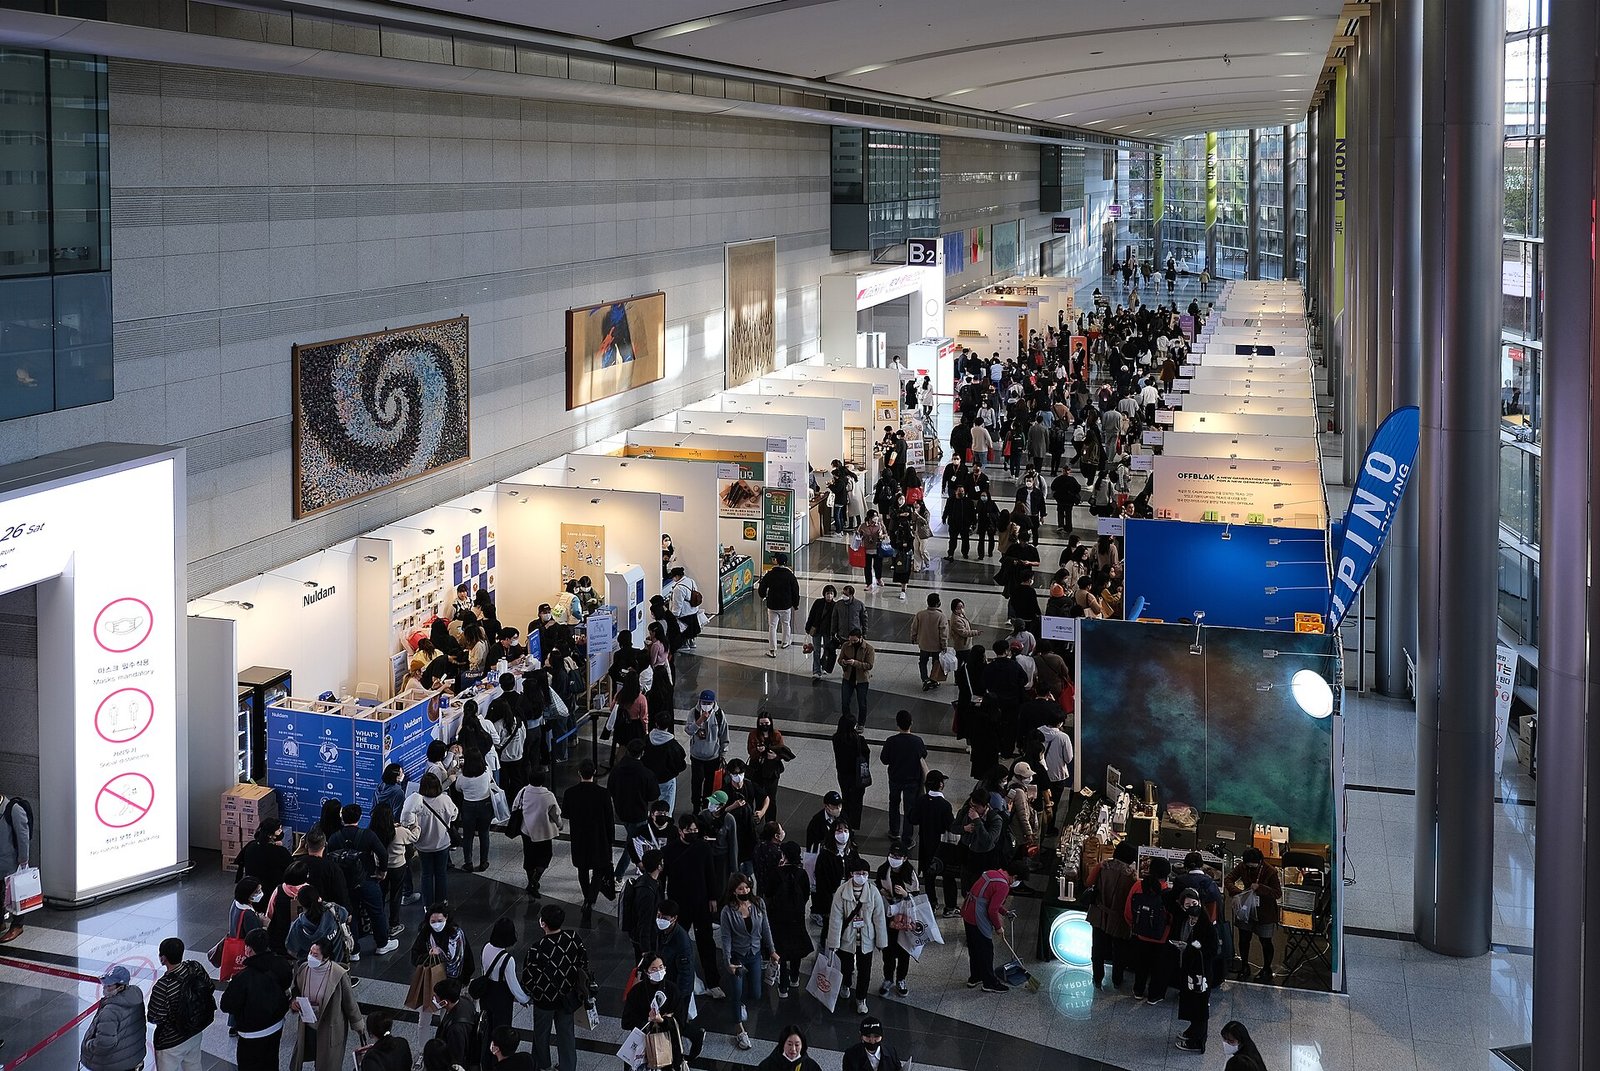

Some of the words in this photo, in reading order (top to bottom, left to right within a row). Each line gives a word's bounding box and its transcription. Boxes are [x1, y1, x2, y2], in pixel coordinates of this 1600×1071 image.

[1207, 153, 1216, 181] North
[910, 243, 935, 264] B2
[1177, 472, 1215, 481] OFFBLAK
[0, 523, 26, 542] 26
[27, 522, 45, 535] Sat
[303, 585, 336, 607] Nuldam
[403, 715, 423, 731] Nuldam
[355, 729, 379, 739] WHAT'S
[355, 742, 380, 751] BETTER?
